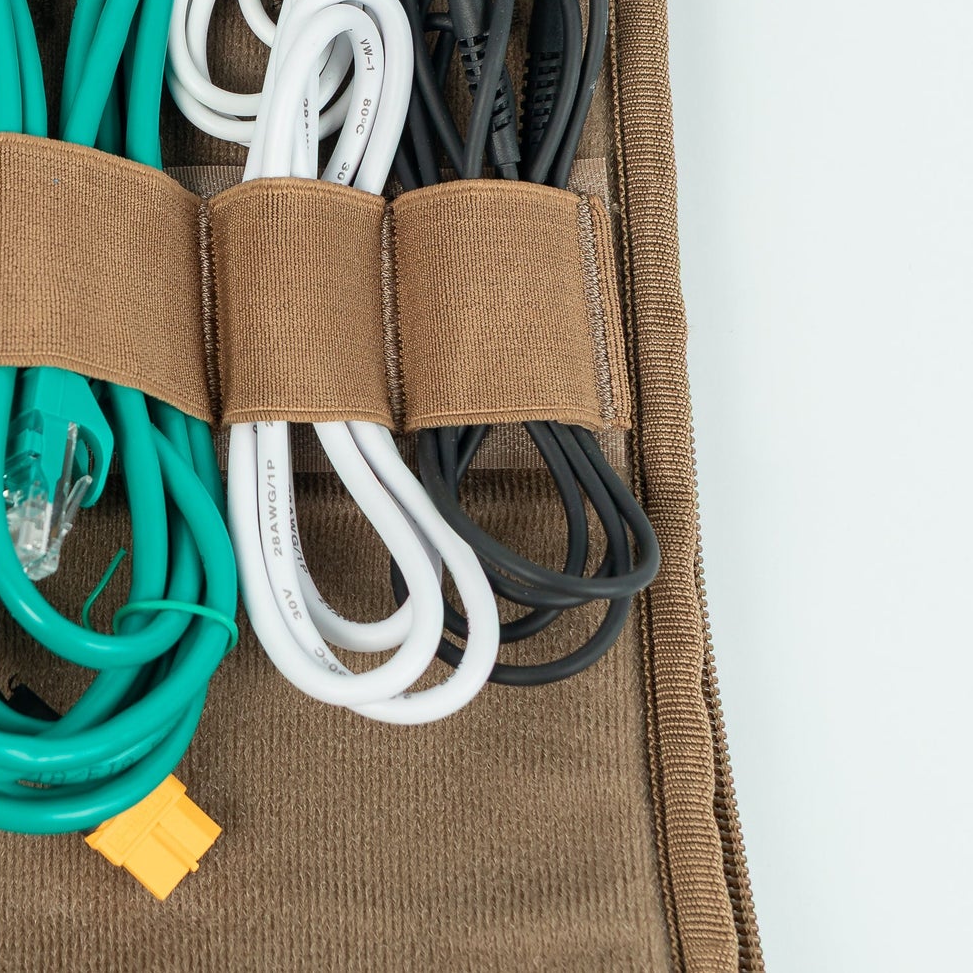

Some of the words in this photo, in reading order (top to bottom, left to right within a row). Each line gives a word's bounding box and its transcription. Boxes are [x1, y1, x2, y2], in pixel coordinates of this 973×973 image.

[359, 38, 375, 72] VW-1
[337, 161, 350, 181] 30
[266, 458, 283, 557] 28AWG/1P
[283, 588, 303, 620] 30V
